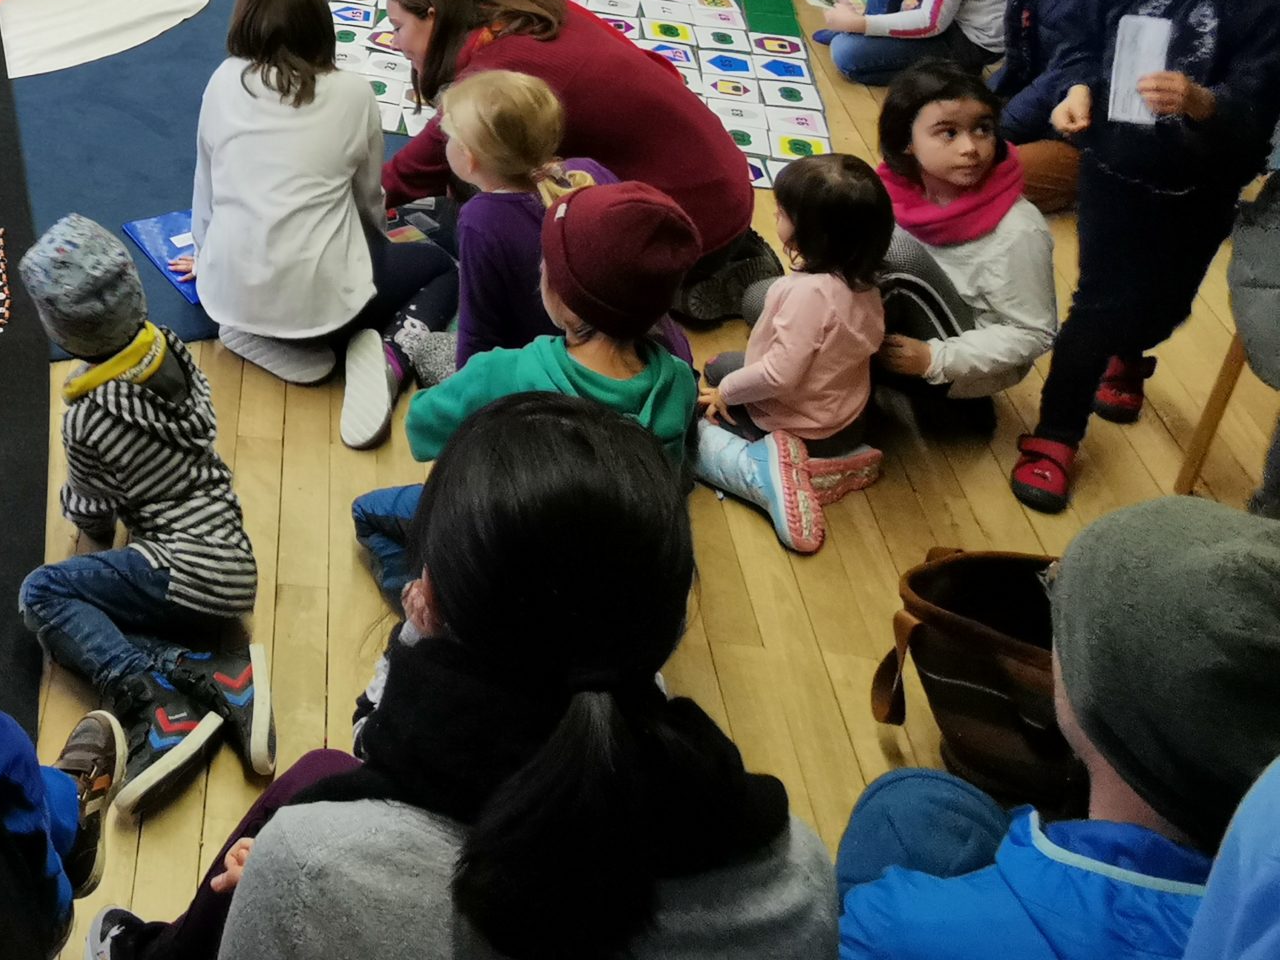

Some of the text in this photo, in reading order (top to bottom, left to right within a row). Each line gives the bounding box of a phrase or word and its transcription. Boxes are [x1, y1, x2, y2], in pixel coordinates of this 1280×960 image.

[351, 10, 362, 18] 15
[661, 6, 673, 14] 77
[384, 61, 398, 71] 23
[795, 117, 810, 127] 93
